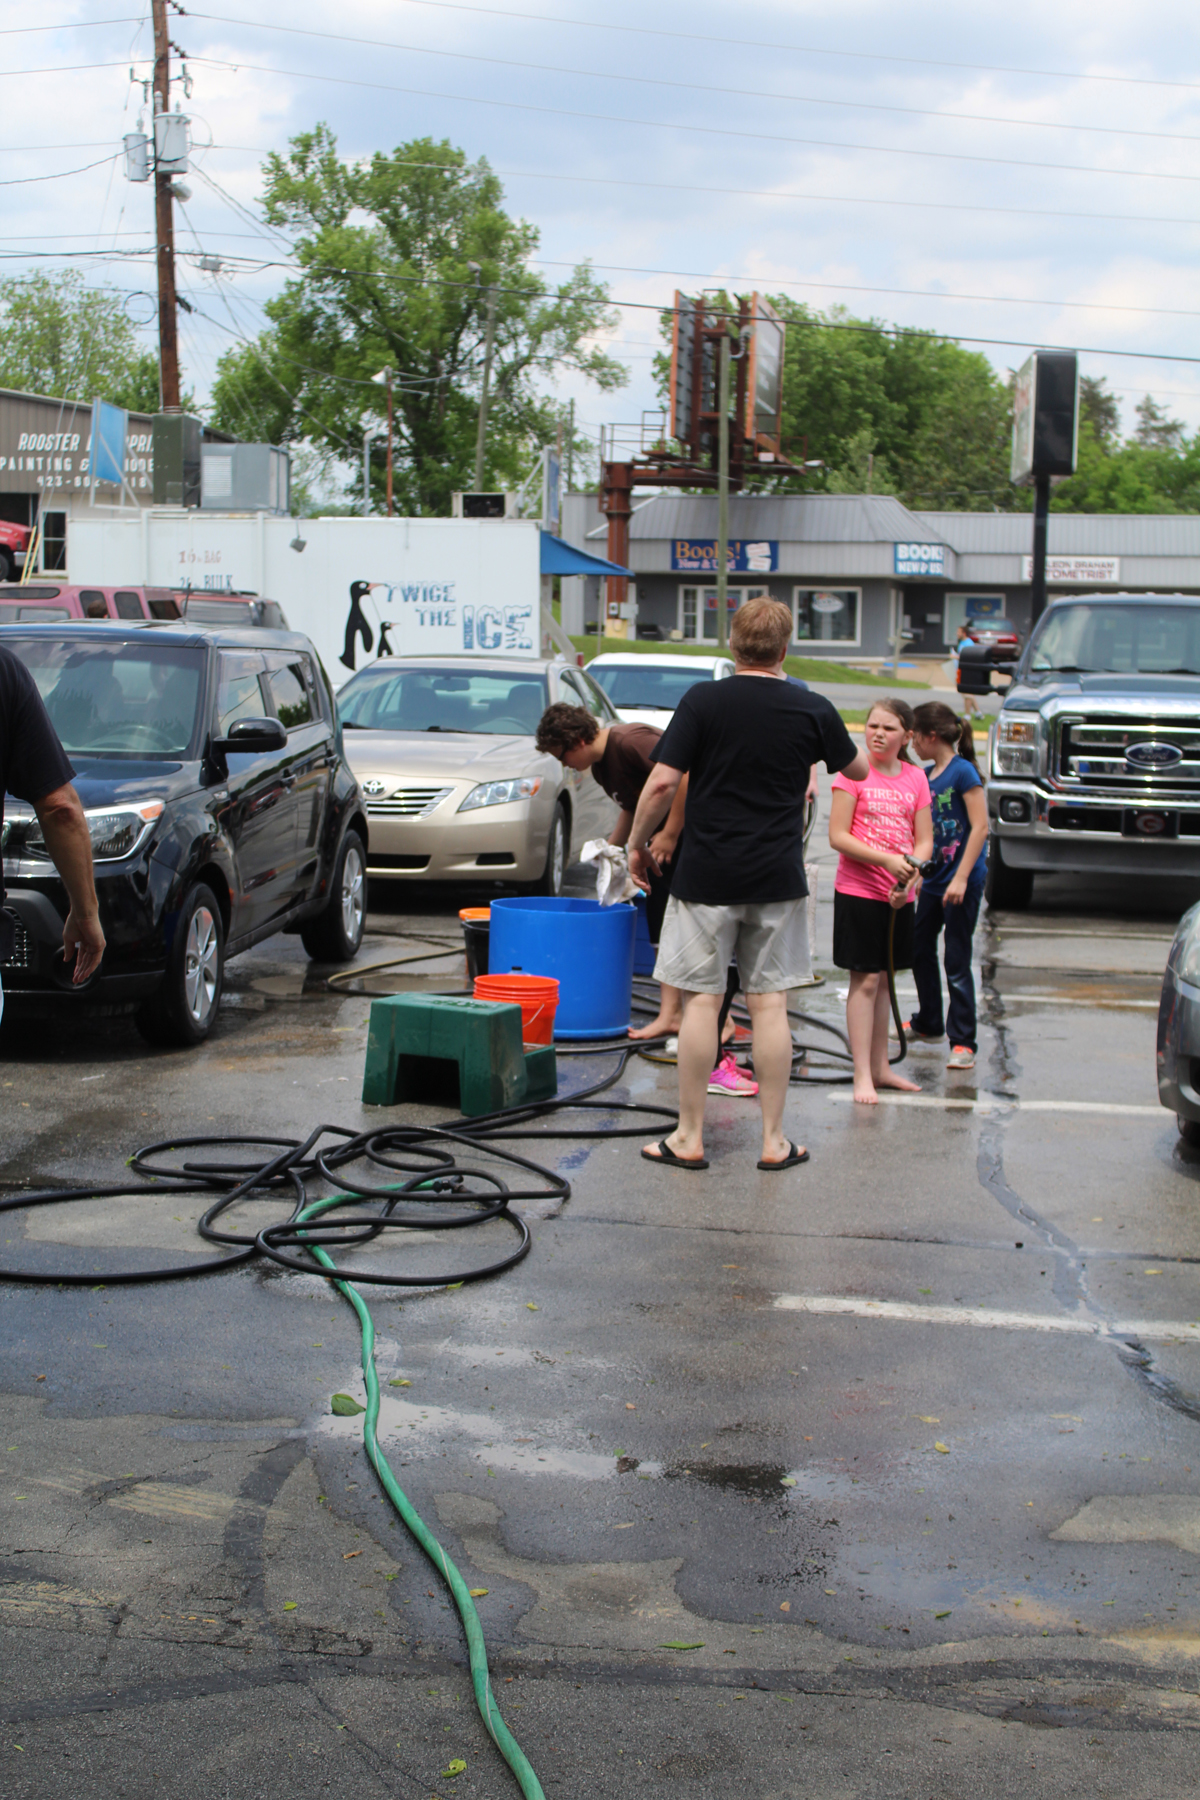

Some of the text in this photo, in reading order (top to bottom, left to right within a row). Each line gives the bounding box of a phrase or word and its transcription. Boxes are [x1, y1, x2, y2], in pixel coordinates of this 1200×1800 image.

[18, 433, 81, 451] ROOSTER
[0, 456, 73, 471] PAINTING
[678, 559, 700, 569] New
[712, 559, 736, 569] Ud
[898, 561, 920, 572] NEW
[1028, 570, 1113, 579] OTOMETRIST
[385, 581, 456, 603] TWICE
[707, 598, 737, 609] ON
[415, 605, 532, 649] THE ICE
[864, 787, 903, 801] TIRED
[868, 801, 906, 816] BEING
